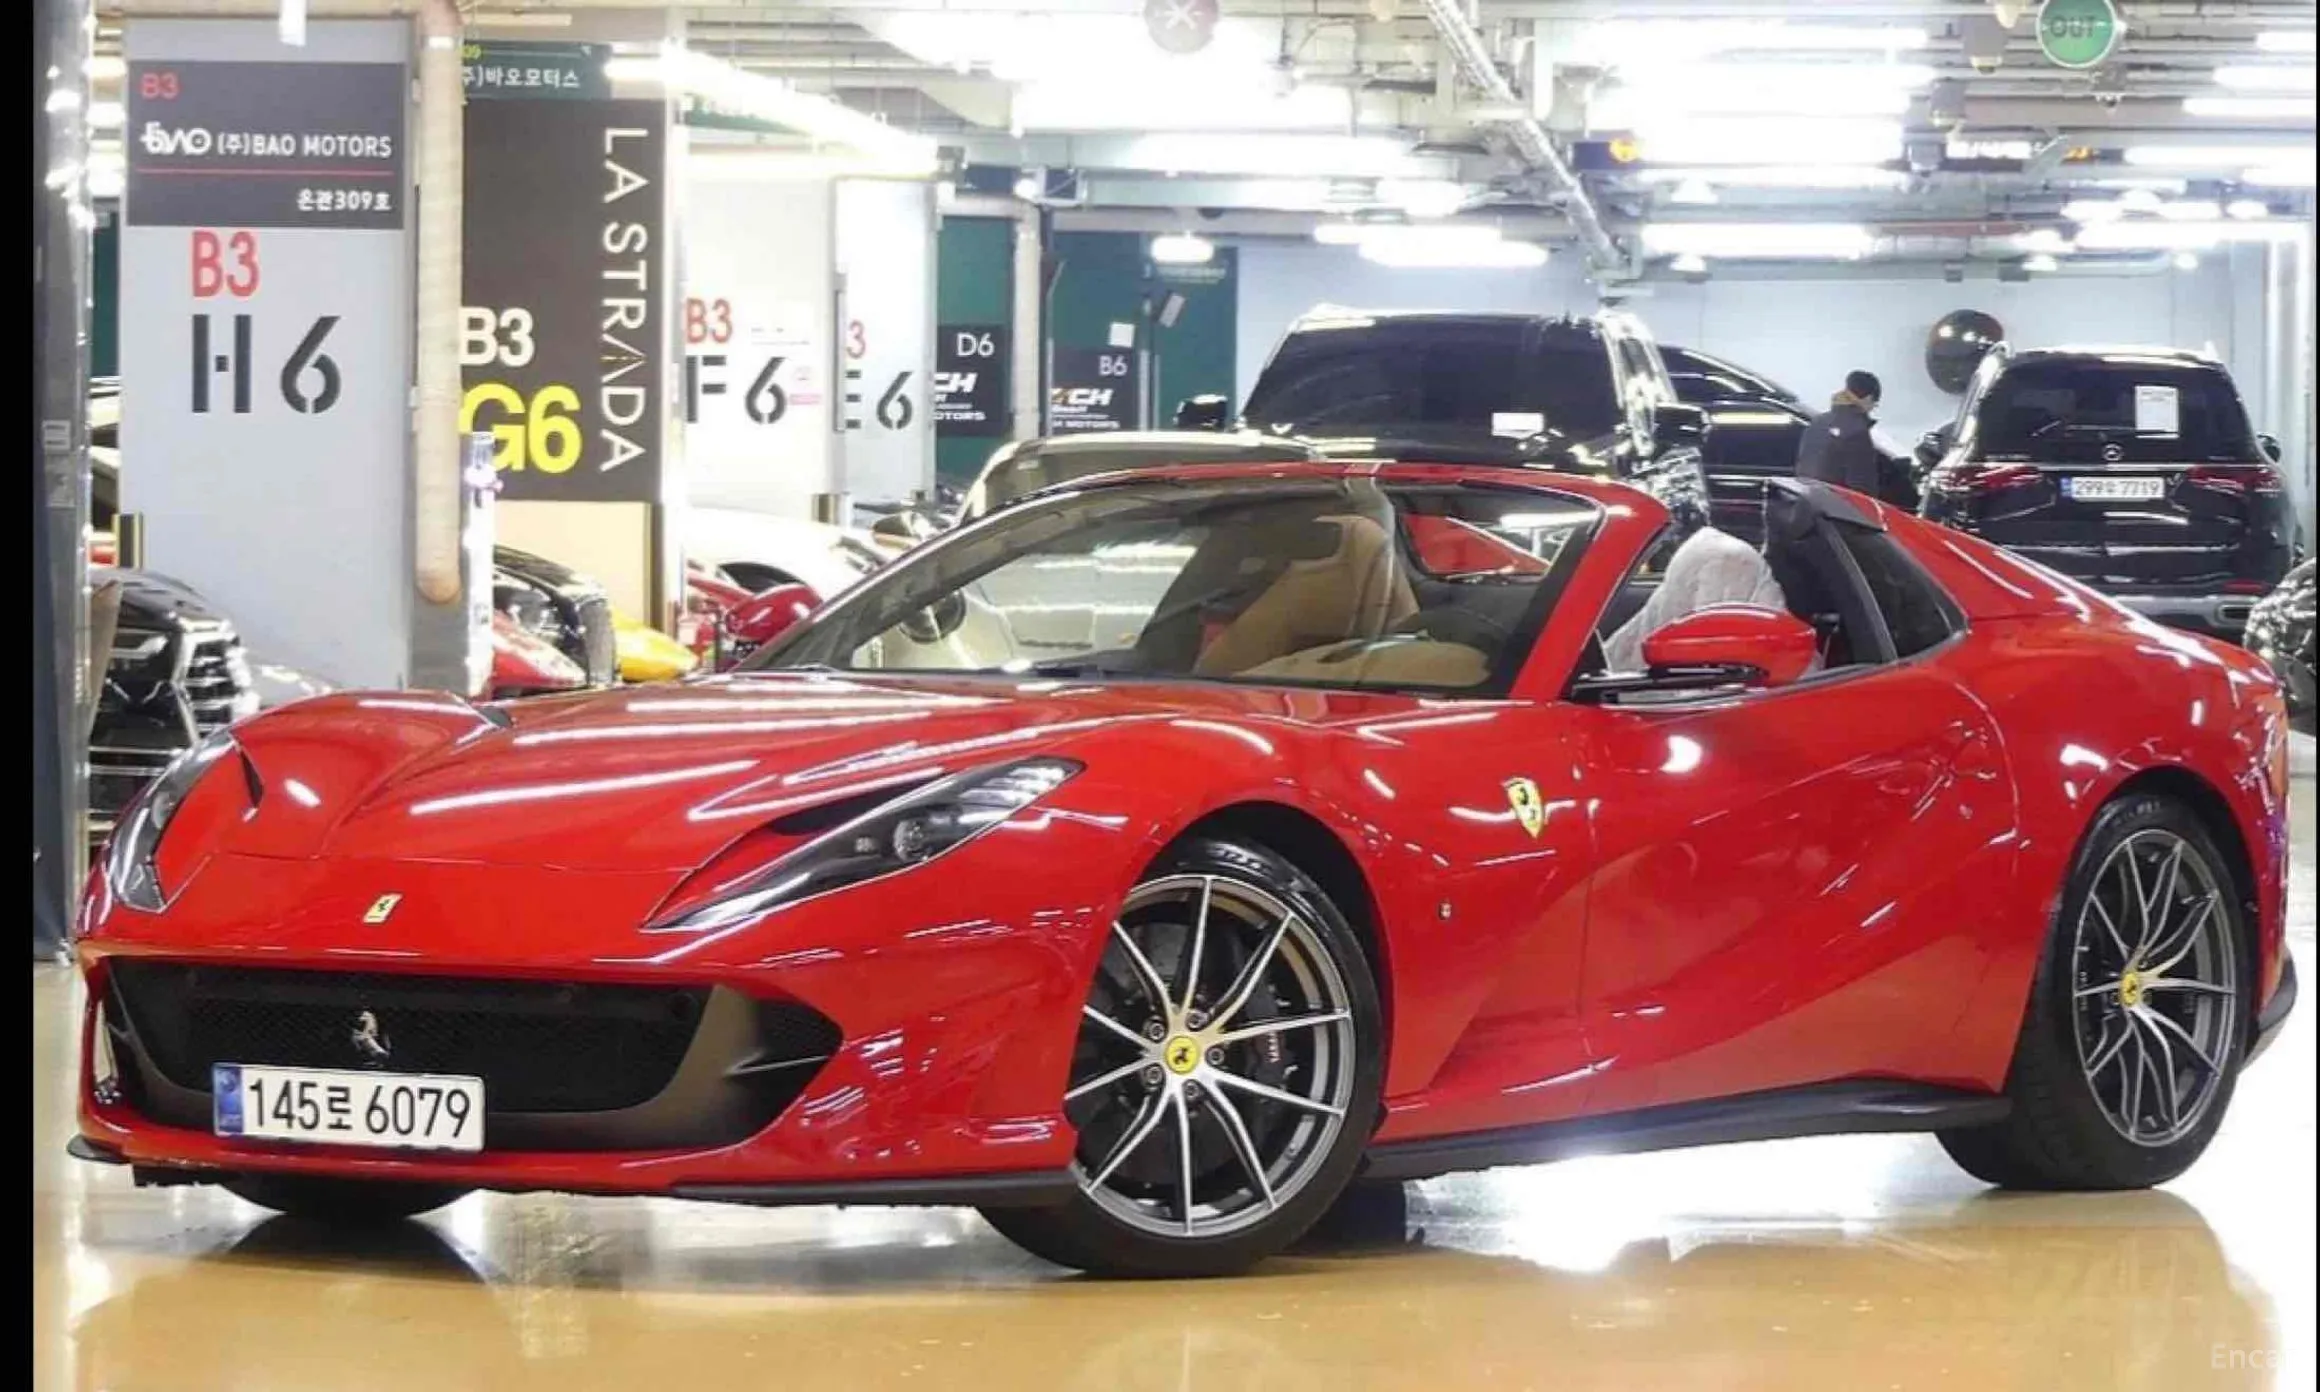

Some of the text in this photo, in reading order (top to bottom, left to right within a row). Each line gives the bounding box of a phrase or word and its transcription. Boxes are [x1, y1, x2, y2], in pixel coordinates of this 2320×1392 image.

[140, 73, 179, 99] B3
[302, 135, 392, 157] MOTORS
[603, 127, 648, 203] LA
[191, 231, 259, 297] B3
[459, 306, 534, 367] B3
[686, 298, 732, 343] B3
[956, 332, 995, 358] D6
[1099, 355, 1128, 377] B6
[458, 382, 583, 474] G6
[250, 1077, 470, 1138] 145로 6079
